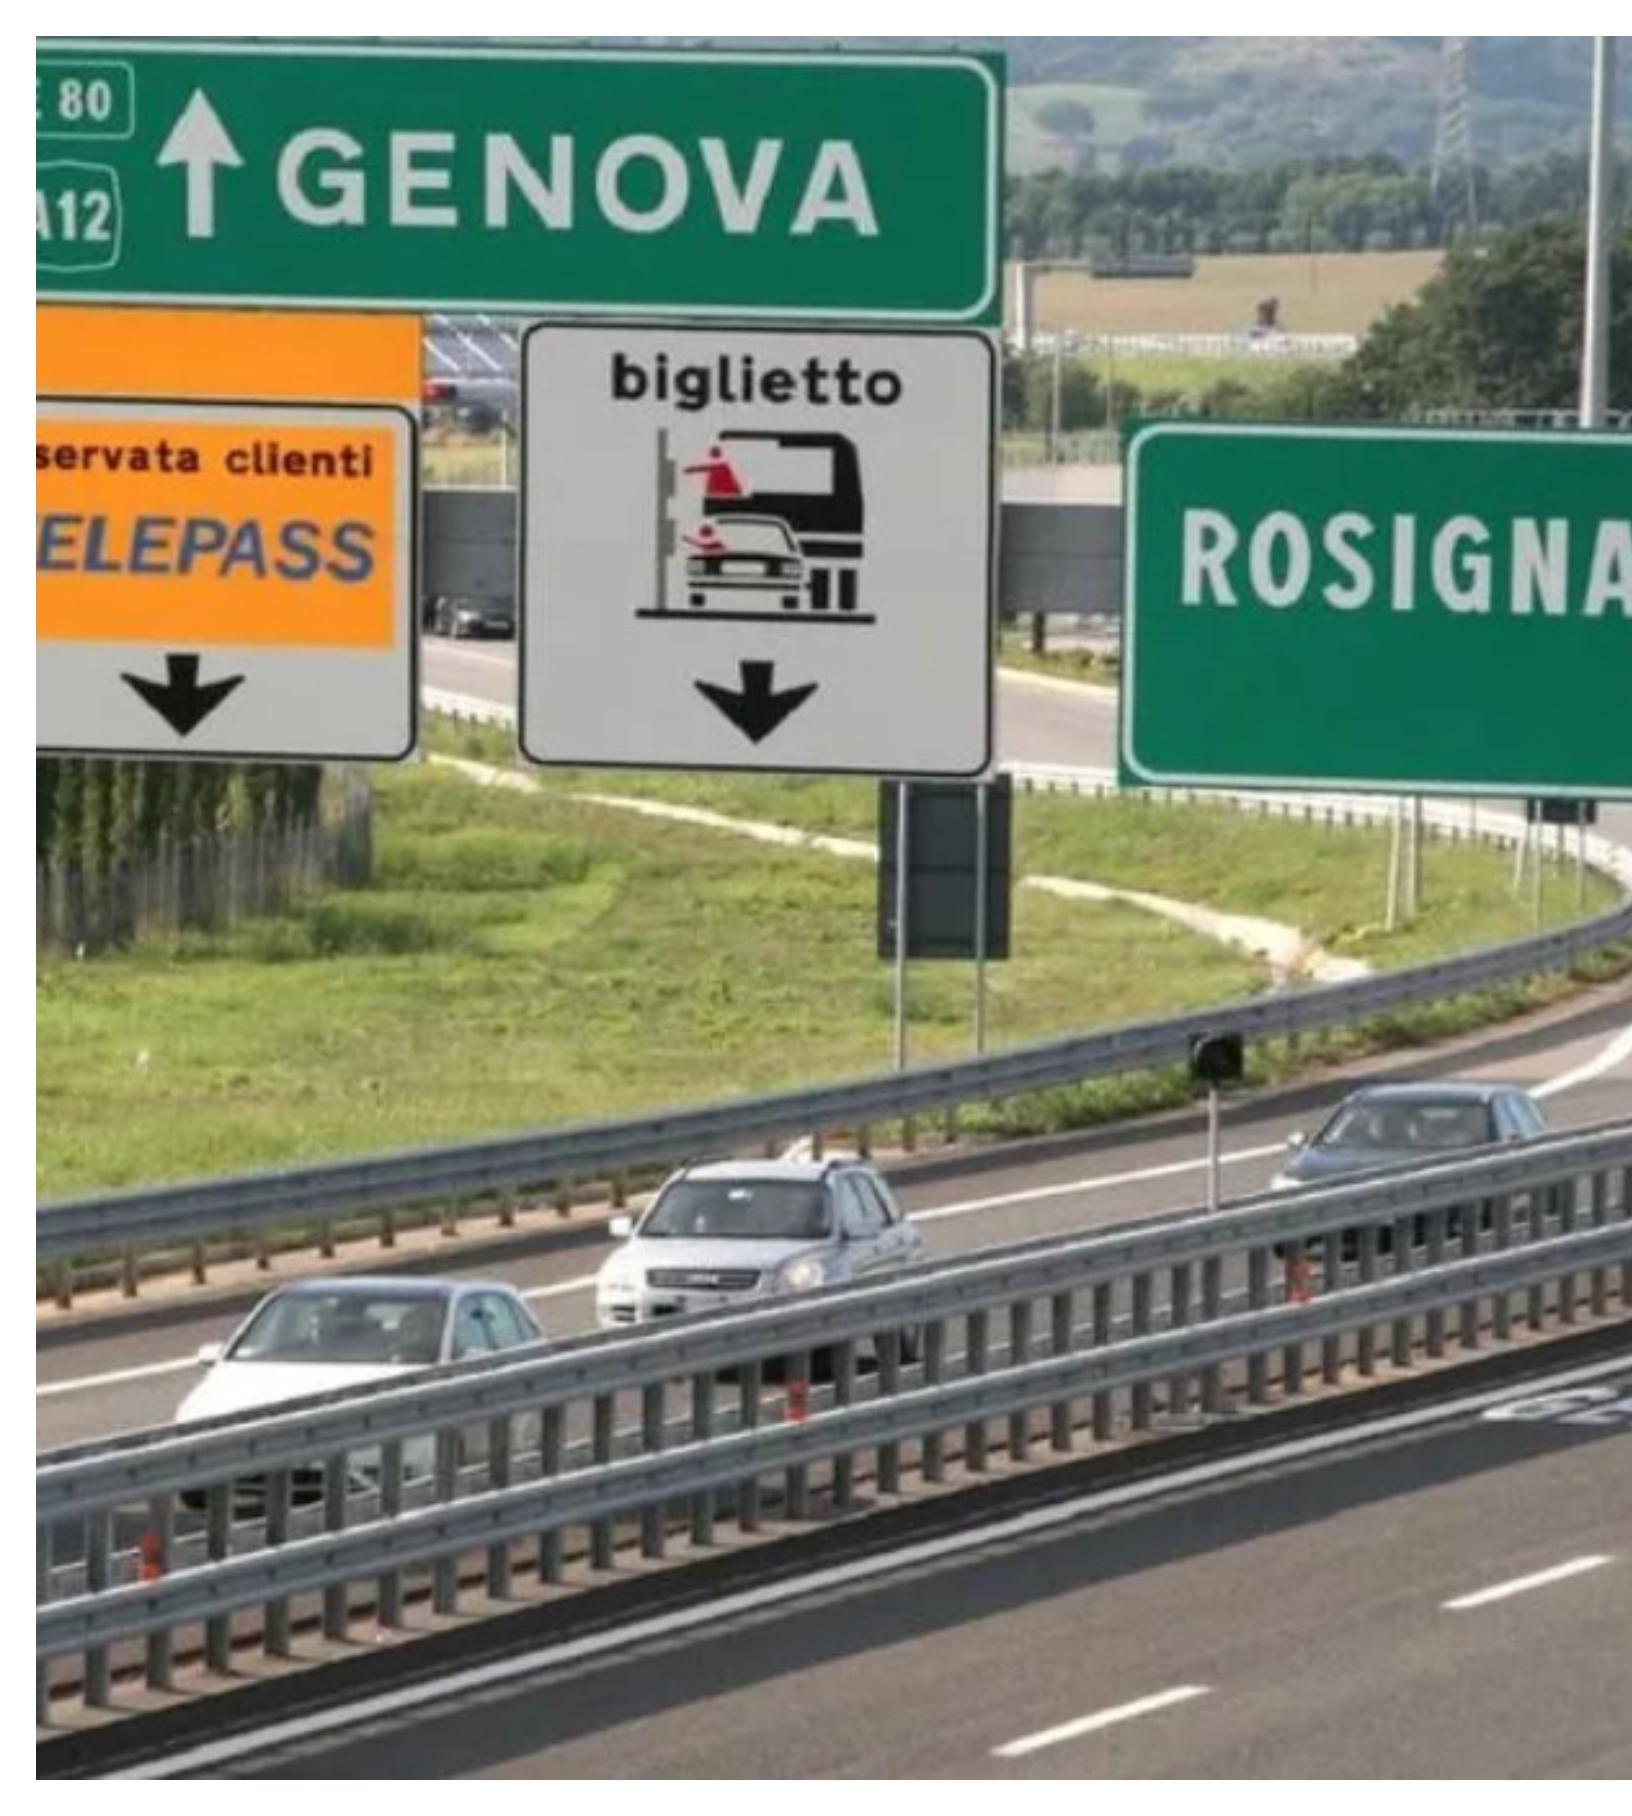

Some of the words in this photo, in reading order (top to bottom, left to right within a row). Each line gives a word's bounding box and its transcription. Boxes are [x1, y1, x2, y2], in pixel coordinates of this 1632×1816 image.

[57, 78, 112, 121] 80
[277, 128, 880, 237] GENOVA
[612, 352, 903, 411] biglietto
[36, 440, 200, 473] servata
[224, 442, 373, 478] clienti
[36, 513, 376, 583] ELEPASS
